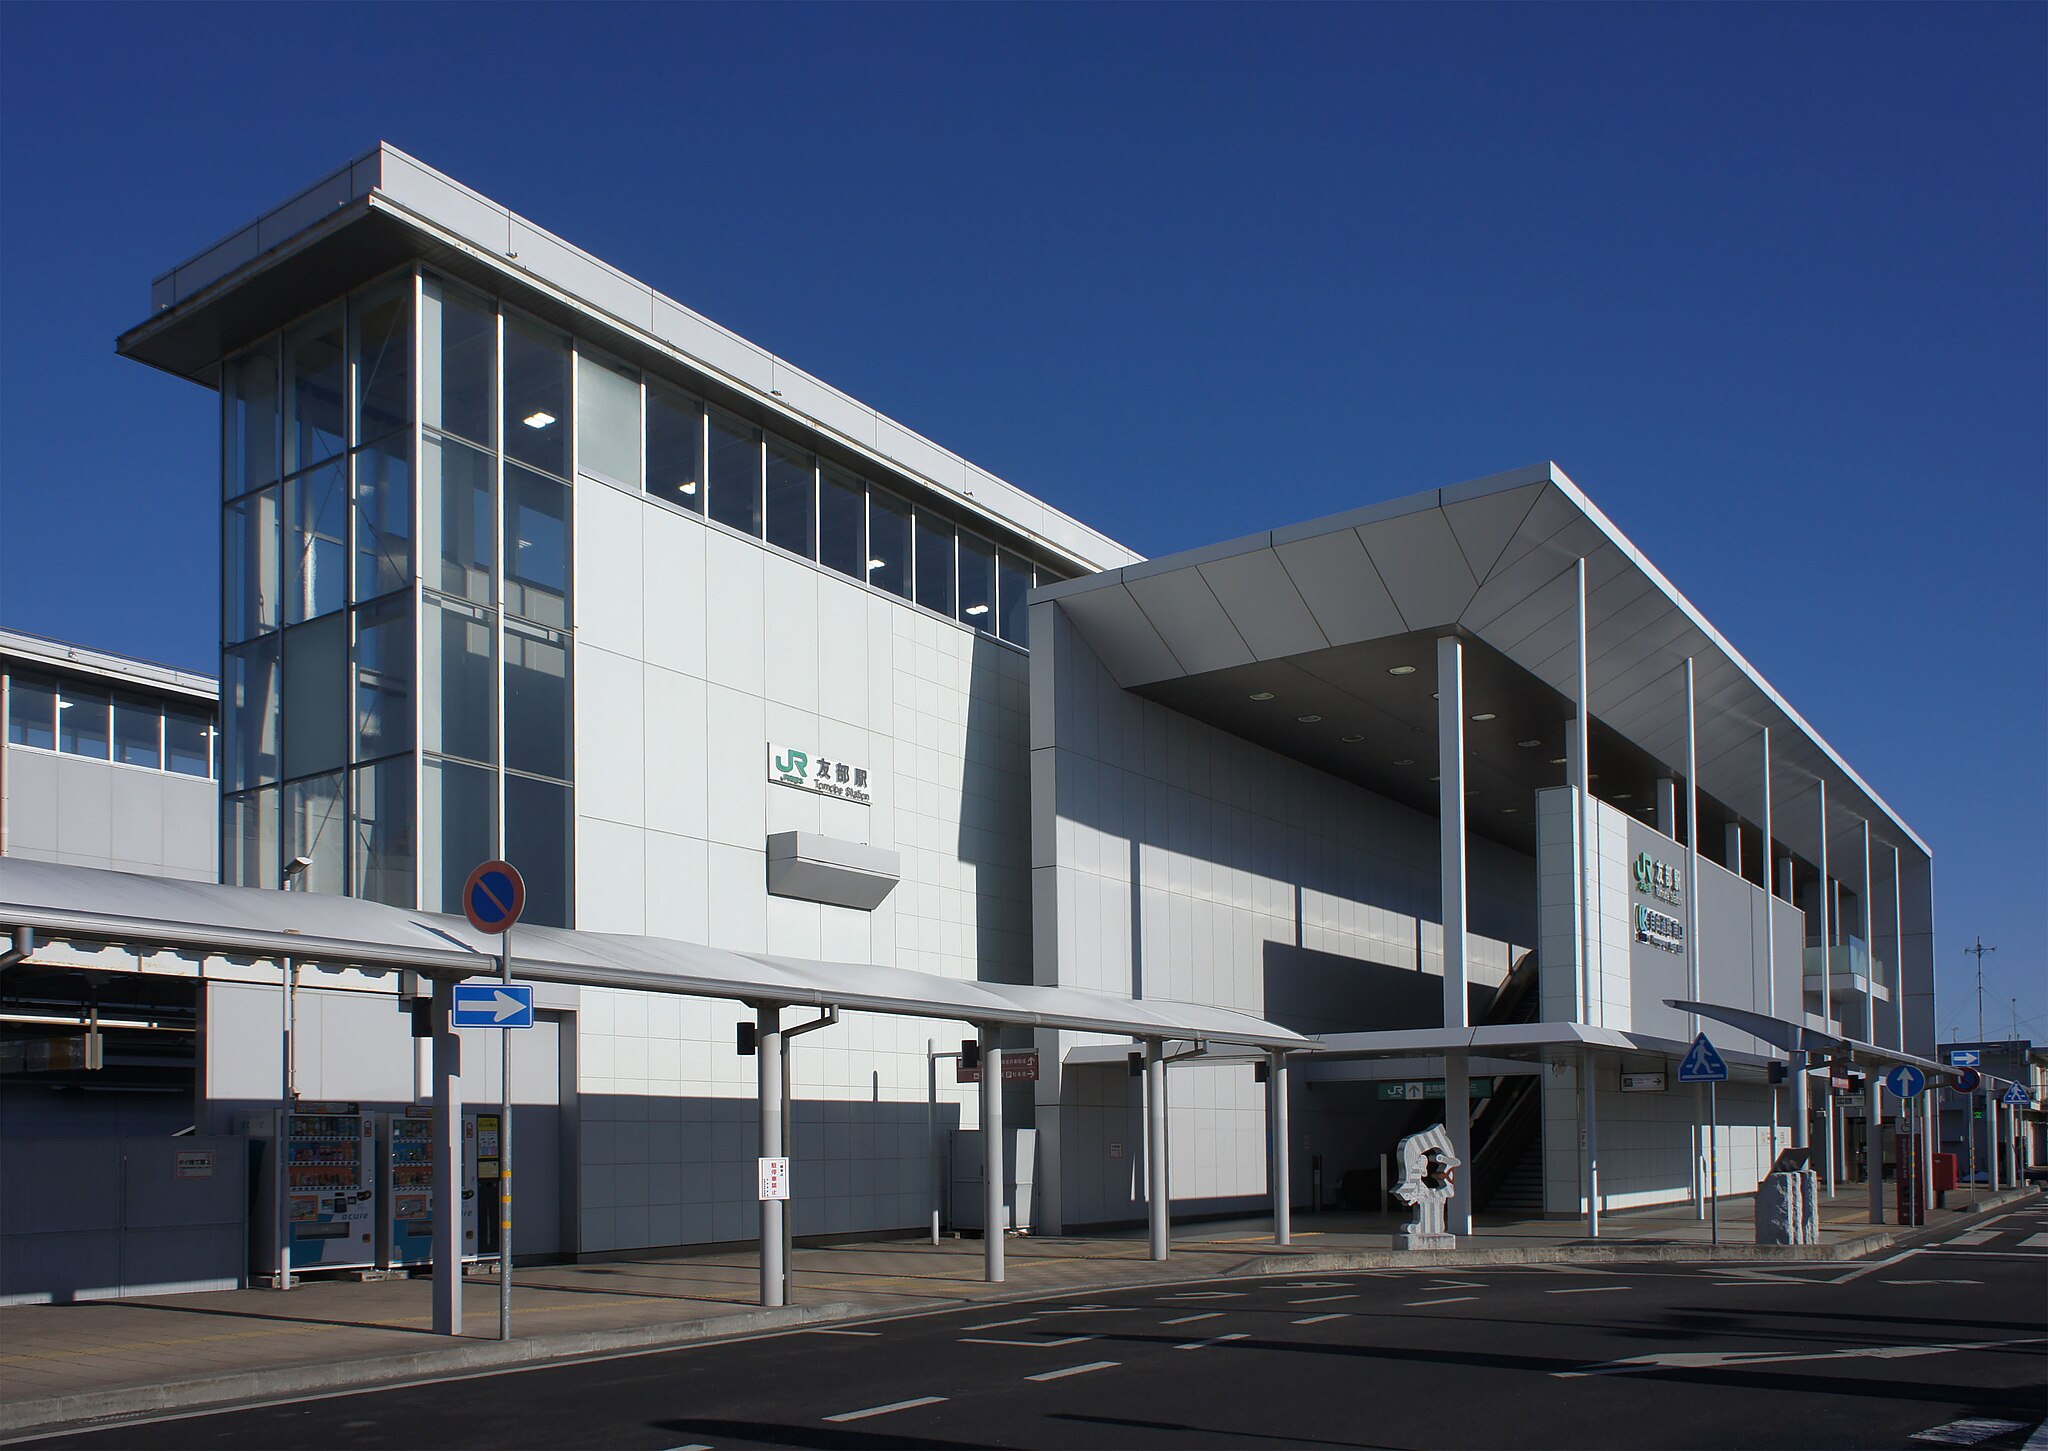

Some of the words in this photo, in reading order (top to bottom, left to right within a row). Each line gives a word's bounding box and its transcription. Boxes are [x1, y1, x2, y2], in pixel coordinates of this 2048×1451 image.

[775, 749, 808, 777] JR
[816, 758, 868, 788] 友部駅
[813, 778, 843, 795] Tomobe
[845, 787, 870, 801] Station
[1387, 1085, 1404, 1095] JR
